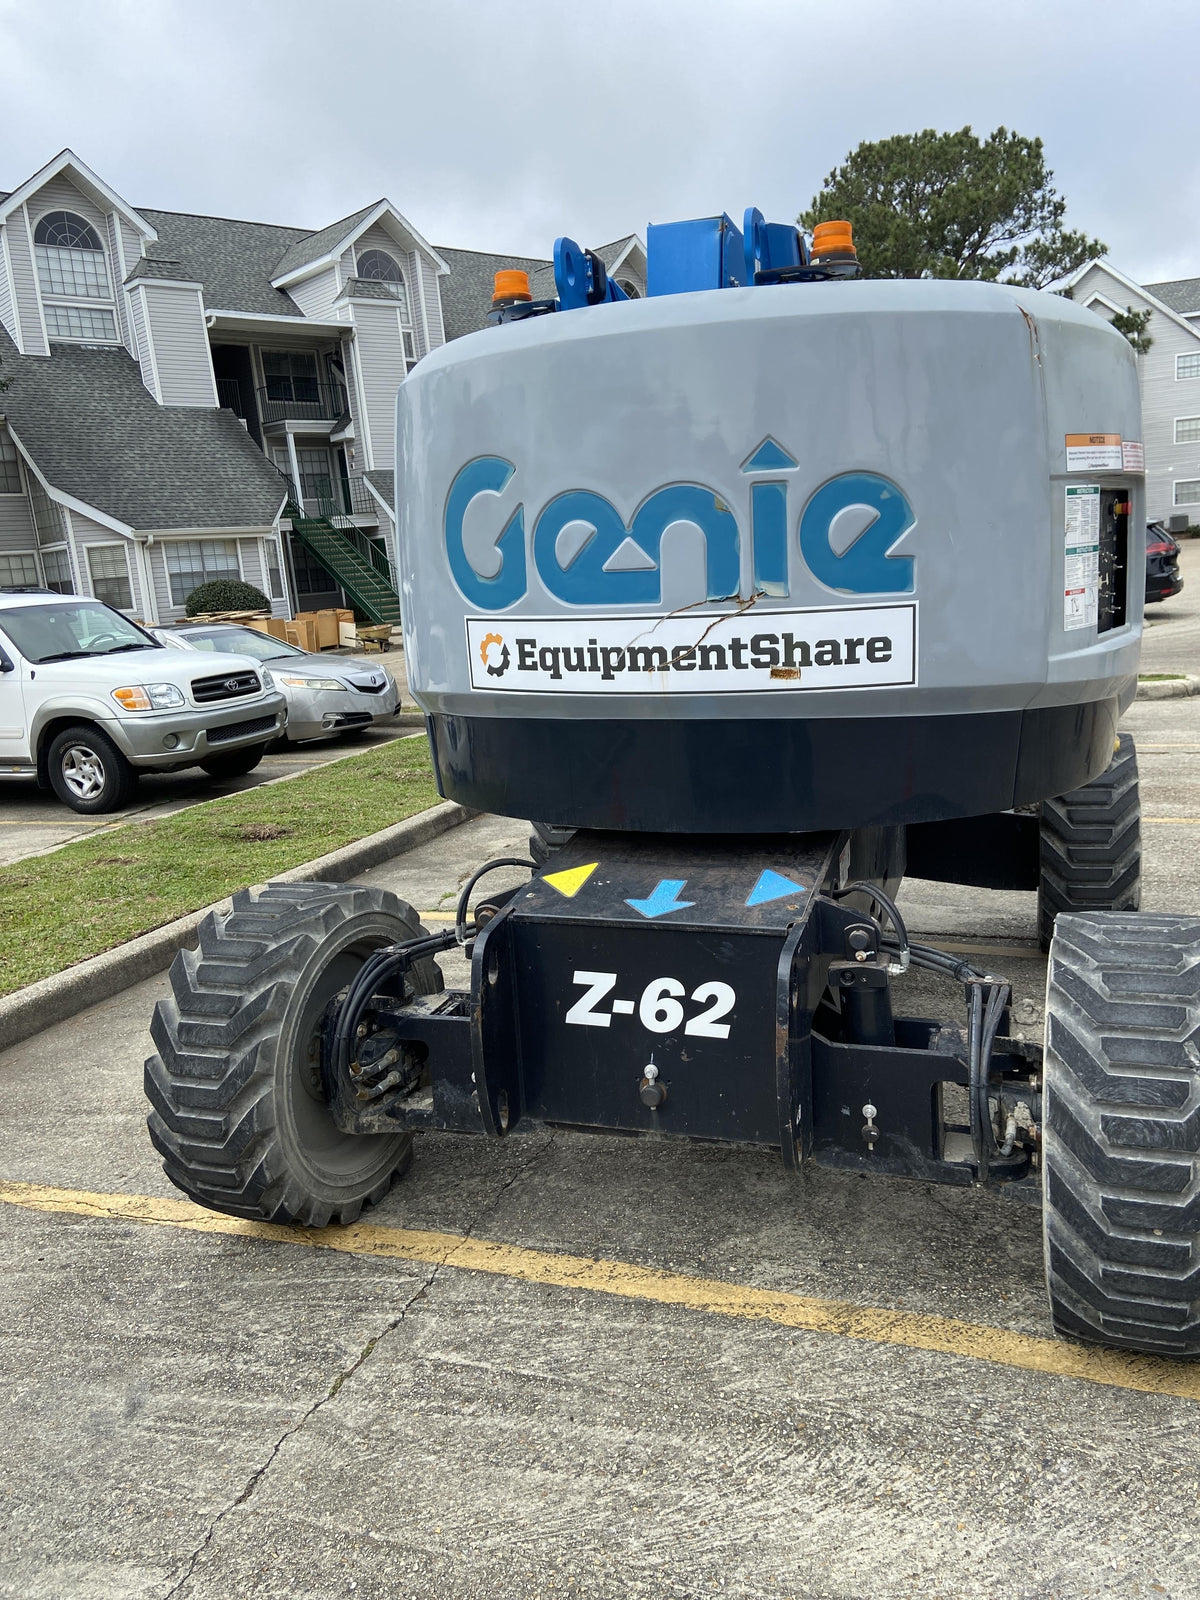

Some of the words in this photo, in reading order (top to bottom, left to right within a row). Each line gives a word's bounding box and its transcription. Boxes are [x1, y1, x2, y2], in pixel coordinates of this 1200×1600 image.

[444, 436, 917, 611] Genie
[516, 632, 893, 680] EquipmentShare
[565, 970, 737, 1040] Z-62
